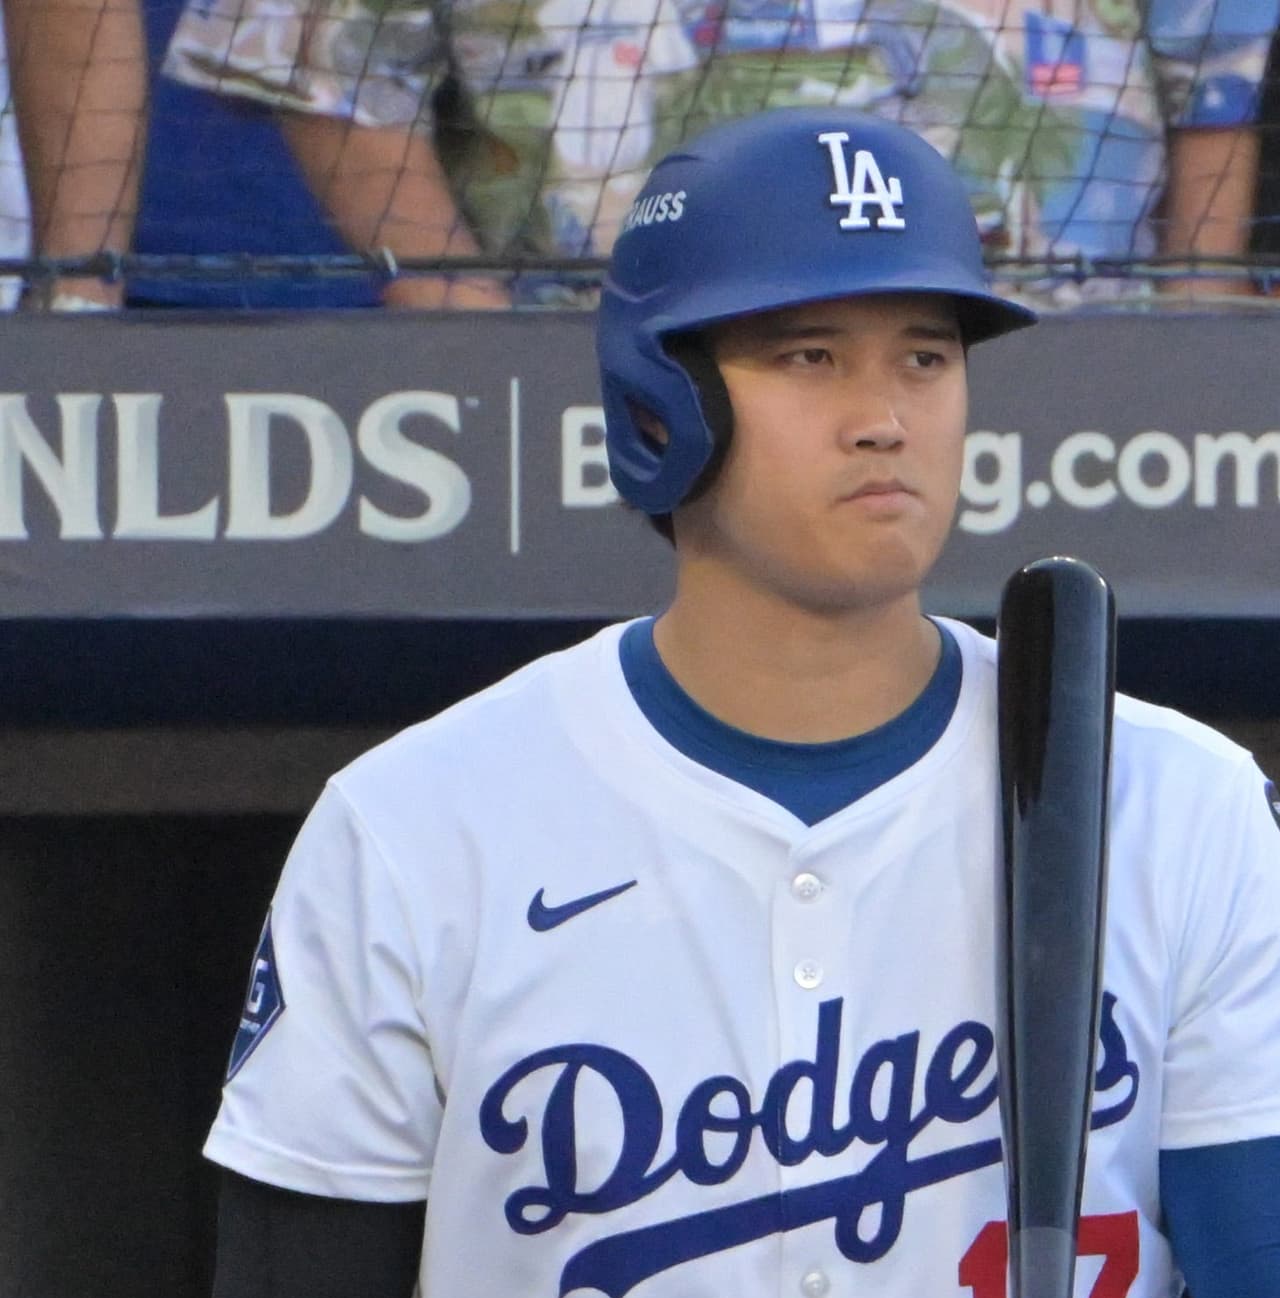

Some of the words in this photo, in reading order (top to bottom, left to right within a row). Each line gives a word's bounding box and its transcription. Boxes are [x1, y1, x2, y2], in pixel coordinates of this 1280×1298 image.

[818, 131, 906, 231] LA
[0, 390, 472, 544] NLDS
[479, 987, 1140, 1264] Dodges
